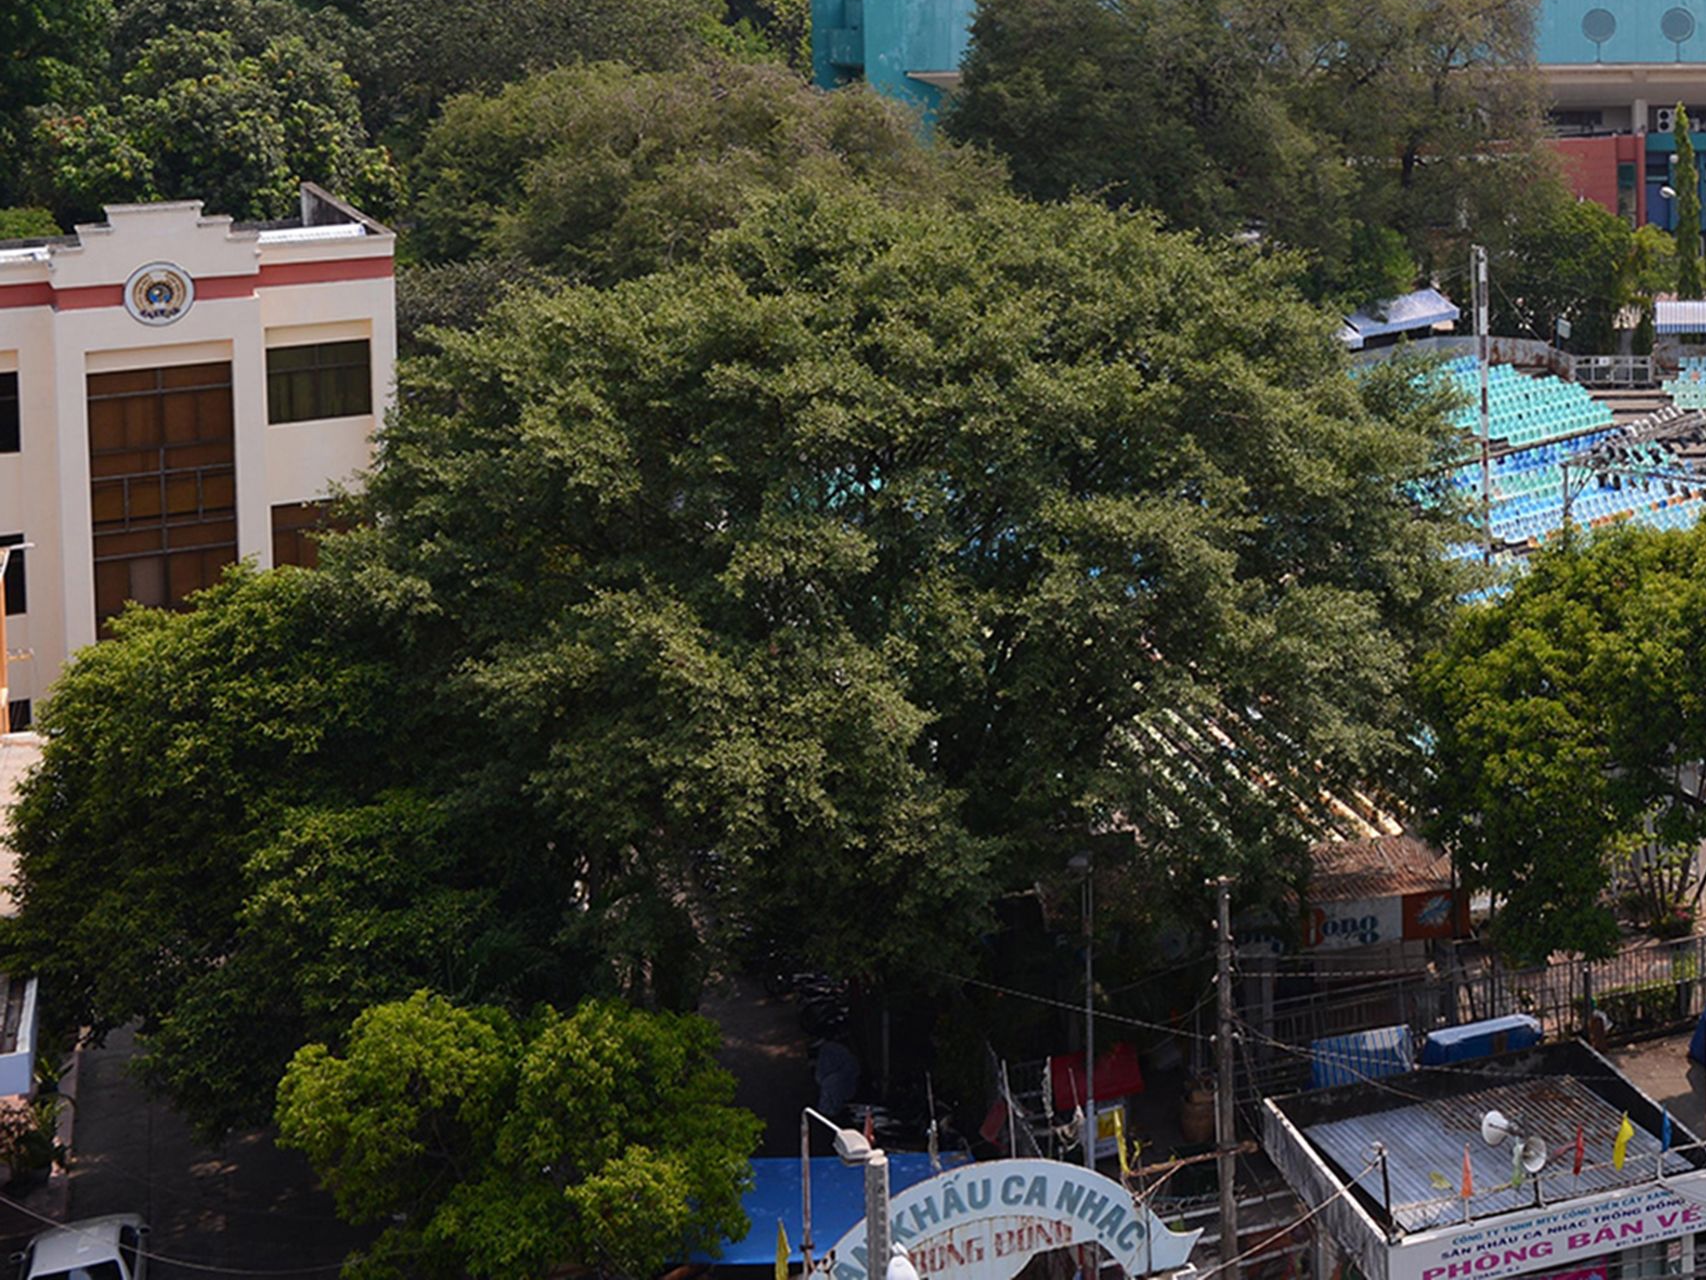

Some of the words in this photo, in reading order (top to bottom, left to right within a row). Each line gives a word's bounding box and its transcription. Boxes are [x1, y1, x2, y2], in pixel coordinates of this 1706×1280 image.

[1000, 1175, 1047, 1207] CA
[1055, 1180, 1145, 1253] NHẠC
[1523, 1229, 1543, 1241] CA
[1567, 1220, 1644, 1250] BÁN
